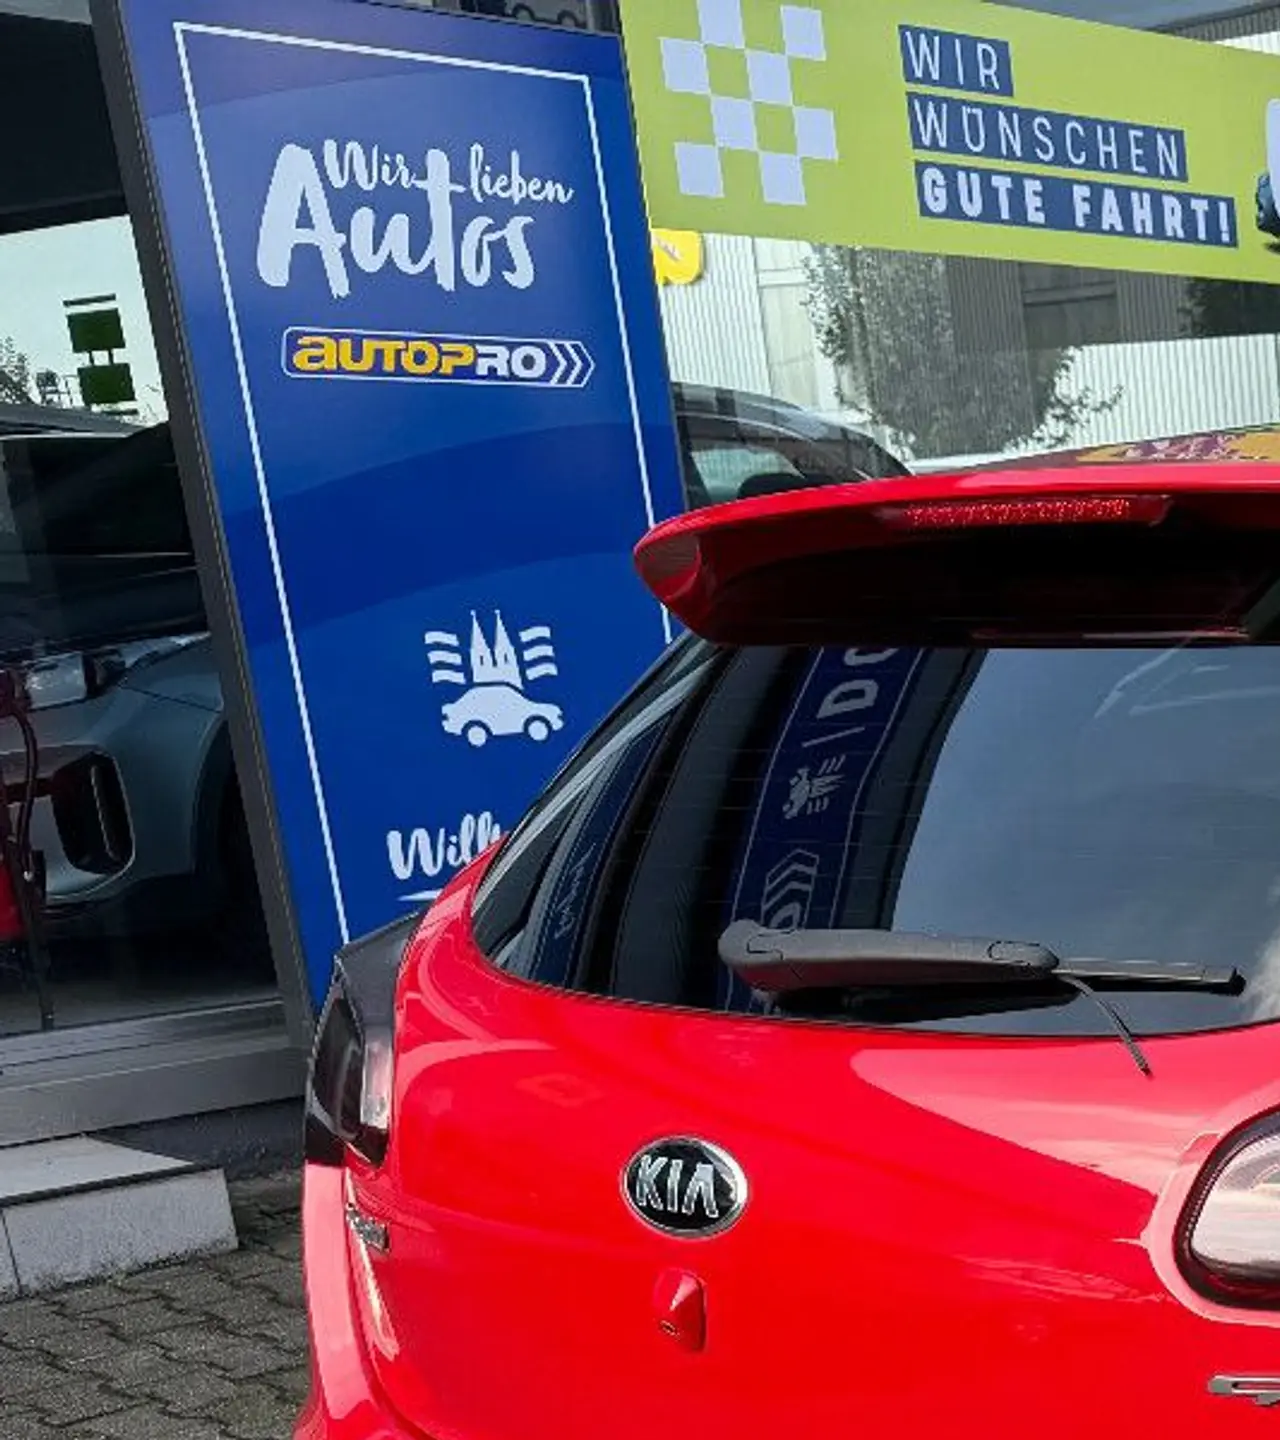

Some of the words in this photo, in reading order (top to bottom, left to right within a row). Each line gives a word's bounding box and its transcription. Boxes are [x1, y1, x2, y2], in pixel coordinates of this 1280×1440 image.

[904, 30, 1000, 90] WIR
[323, 138, 417, 191] Wir
[470, 142, 575, 205] lieben
[914, 98, 1180, 178] WÜNSCHEN
[256, 143, 536, 300] Autos
[921, 167, 1046, 225] GUTE
[1071, 184, 1231, 244] FAHRT!
[636, 1154, 719, 1218] KIA
